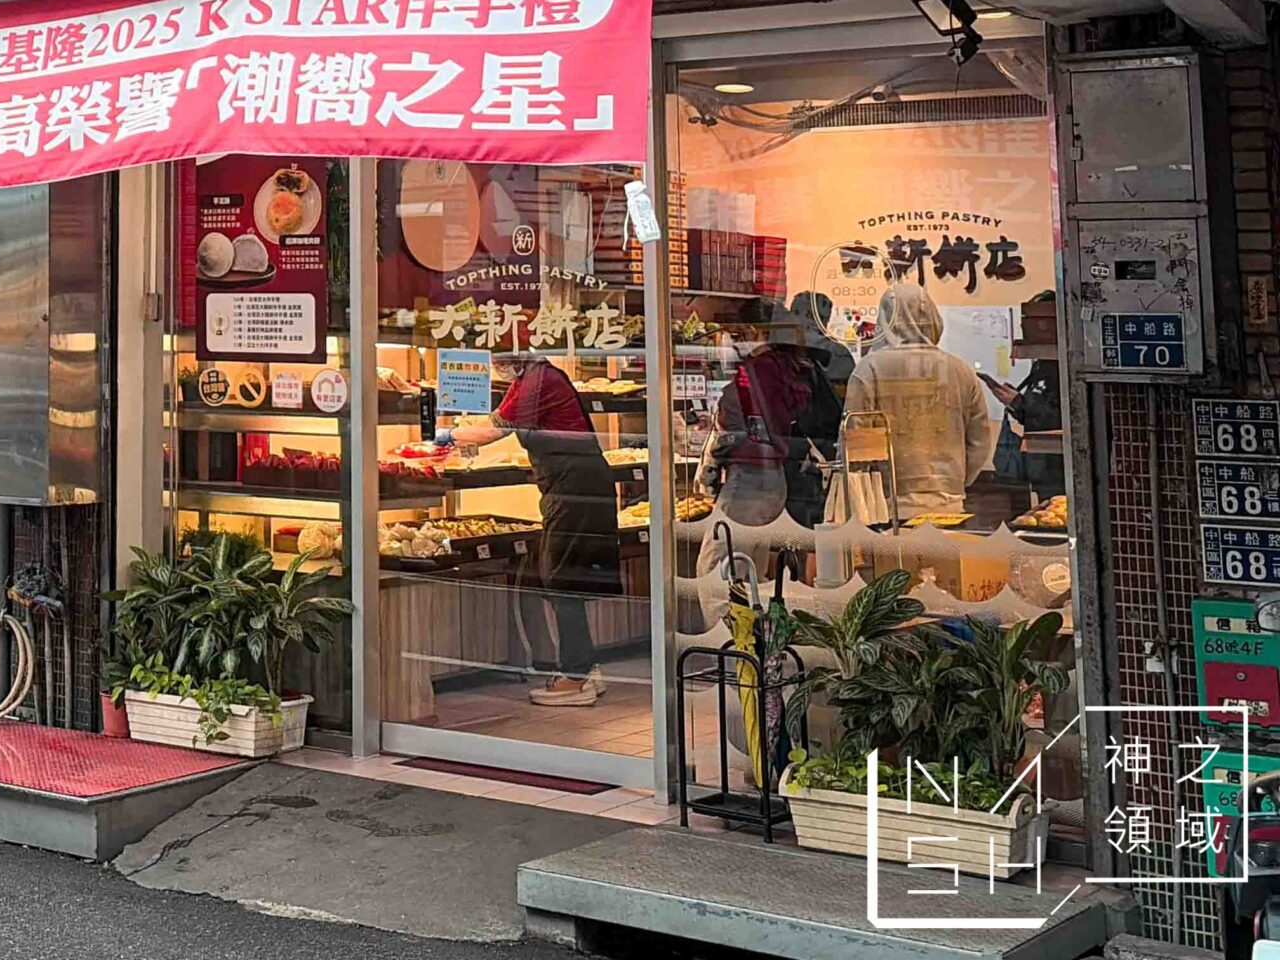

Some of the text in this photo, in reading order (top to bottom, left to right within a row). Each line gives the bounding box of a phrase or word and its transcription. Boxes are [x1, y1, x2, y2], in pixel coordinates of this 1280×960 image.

[0, 7, 185, 75] 基隆2025
[858, 211, 1003, 230] TOPTHING PASTRY
[446, 263, 608, 290] TOPTHING PASTRY
[832, 286, 877, 297] 08:30
[429, 299, 627, 359] 大新餅店
[1124, 321, 1176, 336] 中船路
[1134, 345, 1170, 365] 70
[1215, 404, 1274, 419] 中船路
[1217, 424, 1258, 452] 68
[1221, 486, 1262, 515] 68
[1225, 551, 1267, 581] 68
